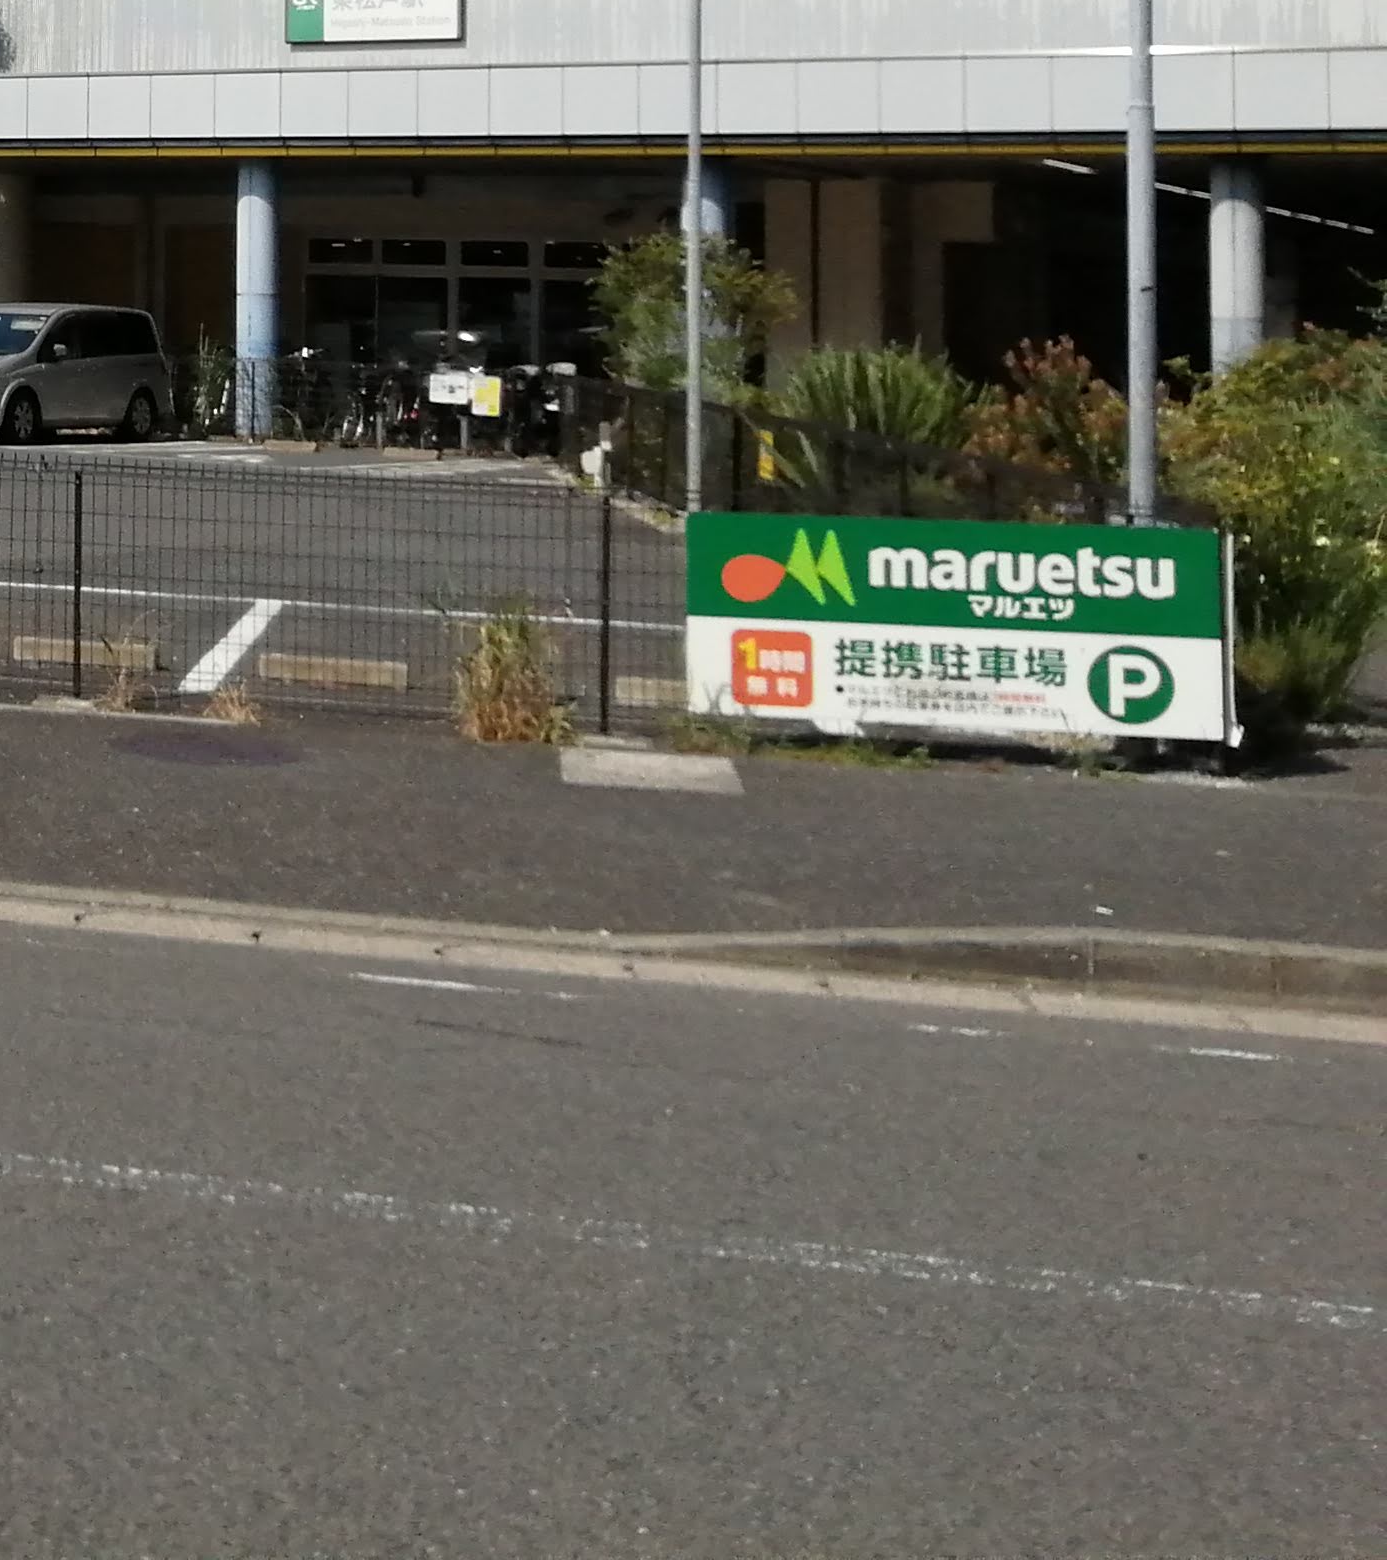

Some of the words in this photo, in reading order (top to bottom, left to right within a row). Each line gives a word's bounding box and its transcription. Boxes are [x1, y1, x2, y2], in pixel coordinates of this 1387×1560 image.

[868, 546, 1176, 600] maruetsu
[968, 594, 1075, 620] マルエツ
[737, 637, 807, 675] 1時間
[834, 639, 1068, 689] 提携駐車場
[1107, 654, 1163, 718] P
